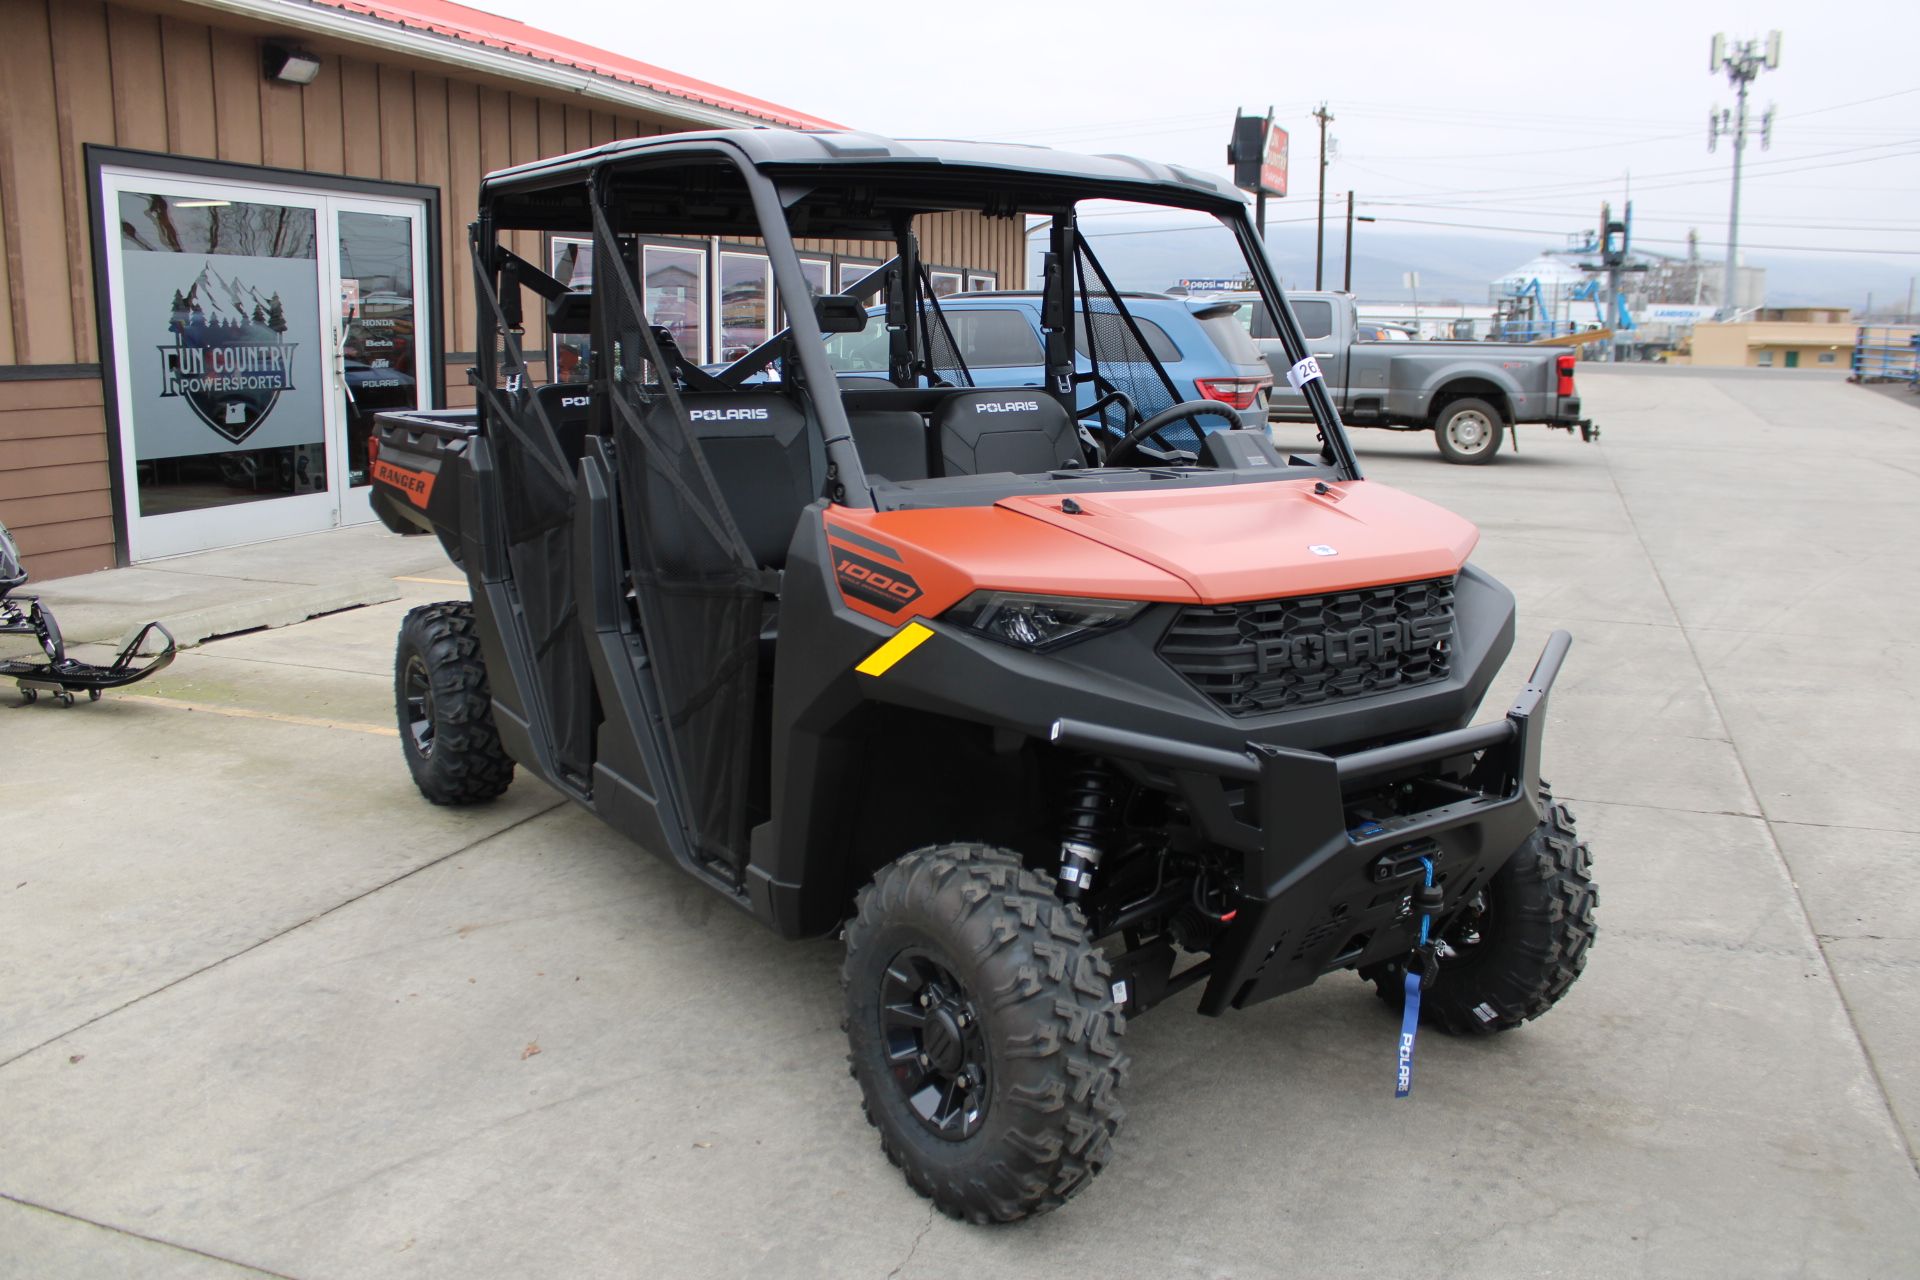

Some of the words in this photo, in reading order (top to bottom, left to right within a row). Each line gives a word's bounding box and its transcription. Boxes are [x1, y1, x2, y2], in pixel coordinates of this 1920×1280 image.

[1190, 280, 1216, 290] pepsi
[362, 319, 395, 327] HONDA
[365, 339, 393, 347] Beta
[371, 358, 390, 369] KTM
[159, 346, 205, 396] FUN
[212, 344, 296, 389] COUNTRY
[181, 375, 282, 393] POWERSPORTS
[362, 379, 400, 388] POLARIS
[975, 401, 1039, 413] POLARIS
[690, 408, 768, 421] POLARIS
[379, 465, 425, 494] RANGER
[838, 560, 916, 598] 1000
[1256, 614, 1440, 674] POLARIS
